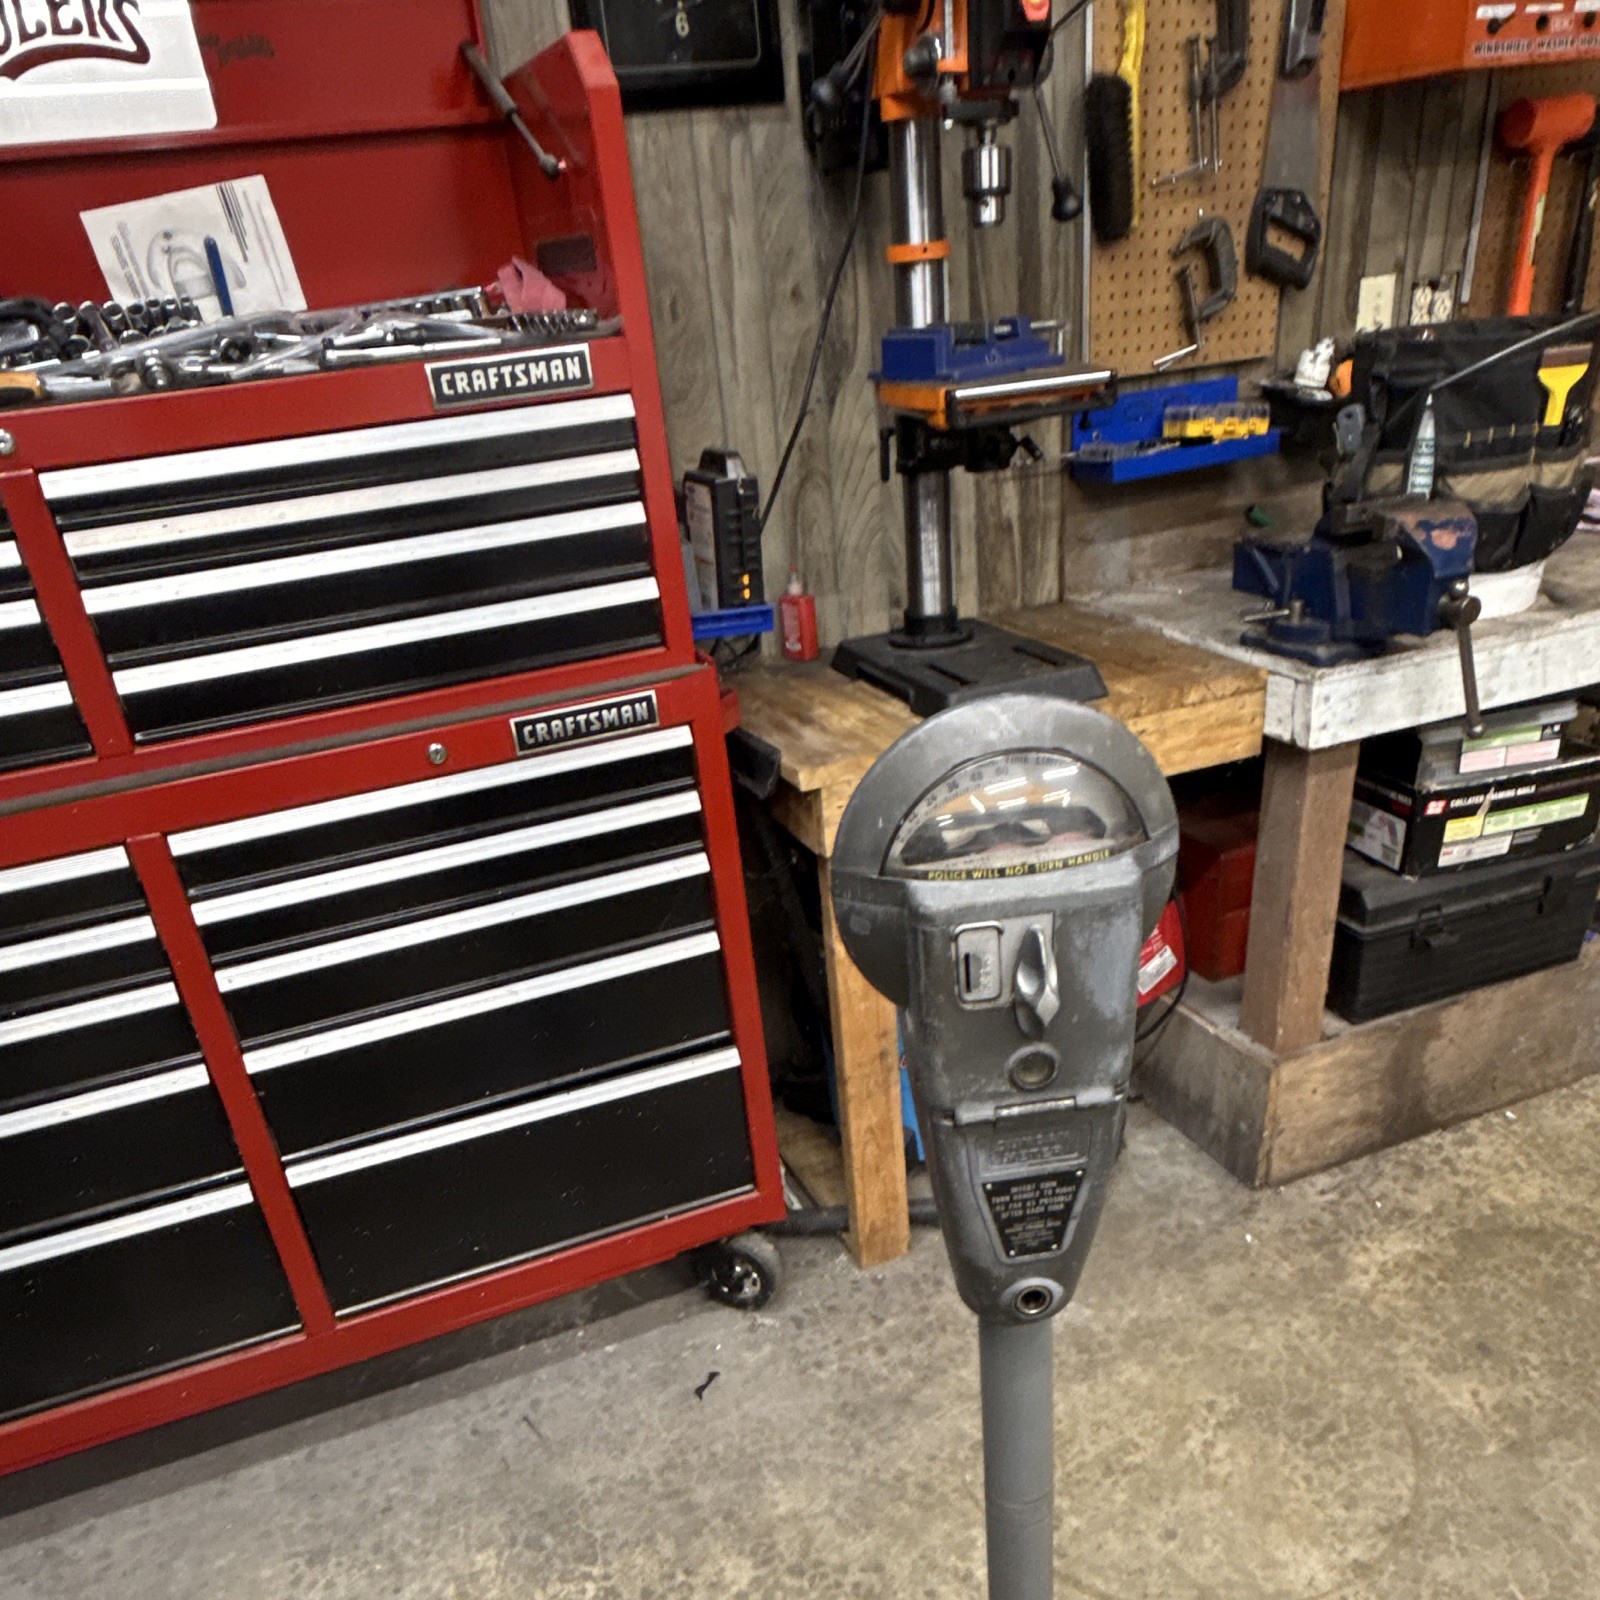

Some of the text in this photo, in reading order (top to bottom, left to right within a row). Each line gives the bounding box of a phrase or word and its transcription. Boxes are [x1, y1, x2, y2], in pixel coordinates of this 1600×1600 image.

[675, 10, 690, 38] 6
[440, 356, 582, 396] CRAFTSMAN
[523, 701, 649, 745] CRAFTSMAN
[928, 849, 1110, 880] POLICE WILL NOT TURN HANDLE
[992, 1185, 1076, 1203] TURN HANDLE TO RIGHT
[1008, 1201, 1023, 1210] FAR
[1026, 1200, 1036, 1208] AS
[1039, 1194, 1074, 1204] POSSIBLE
[1001, 1210, 1023, 1219] AFTER
[1026, 1206, 1046, 1214] EACH
